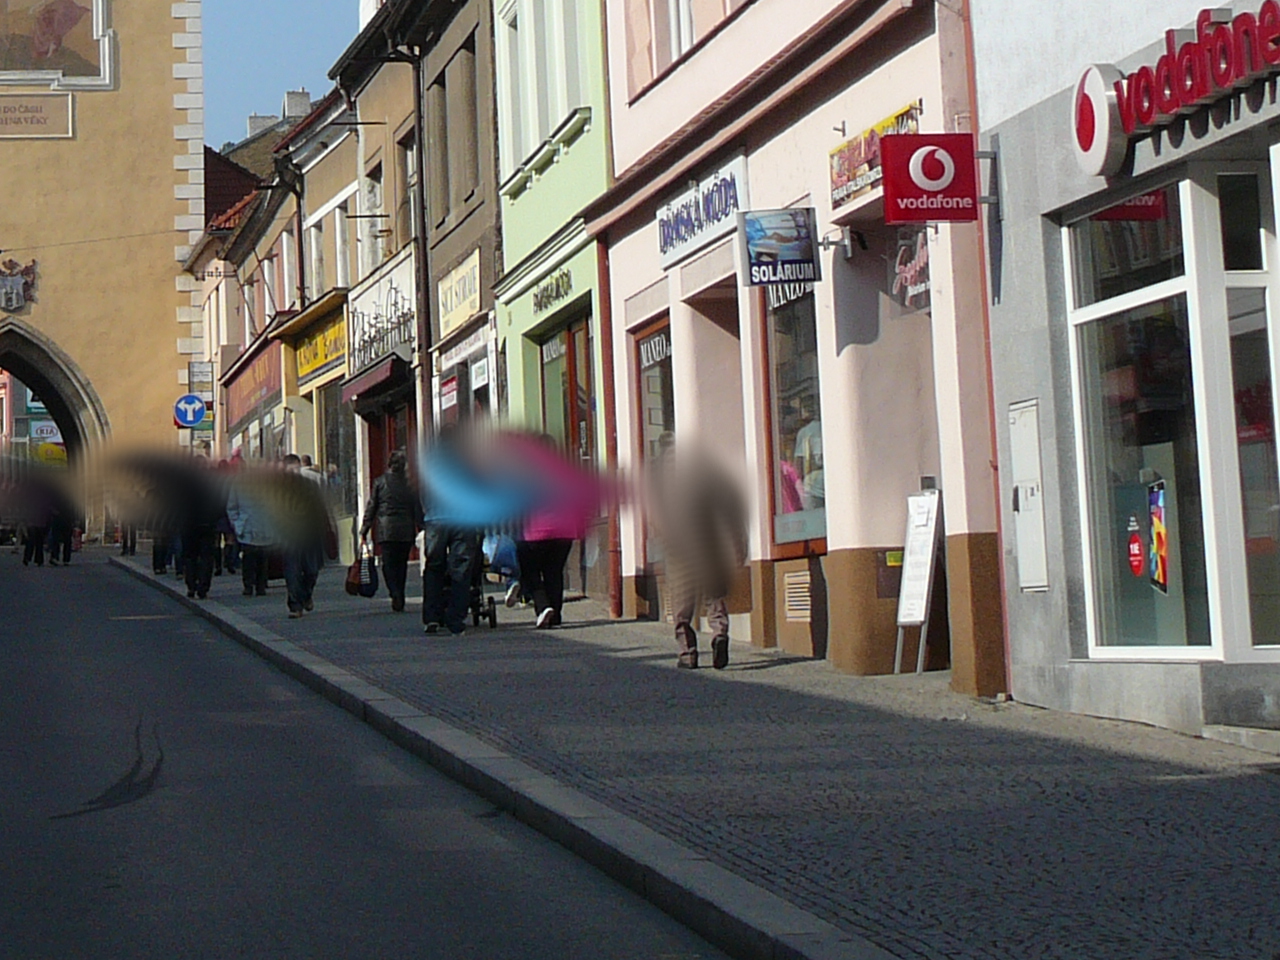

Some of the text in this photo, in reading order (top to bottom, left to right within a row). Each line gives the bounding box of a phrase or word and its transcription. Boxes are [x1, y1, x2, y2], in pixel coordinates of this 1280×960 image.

[1113, 0, 1280, 134] vodafone
[3, 106, 16, 114] DO
[896, 194, 973, 209] vodafone
[751, 260, 814, 283] SOLÁRIUM
